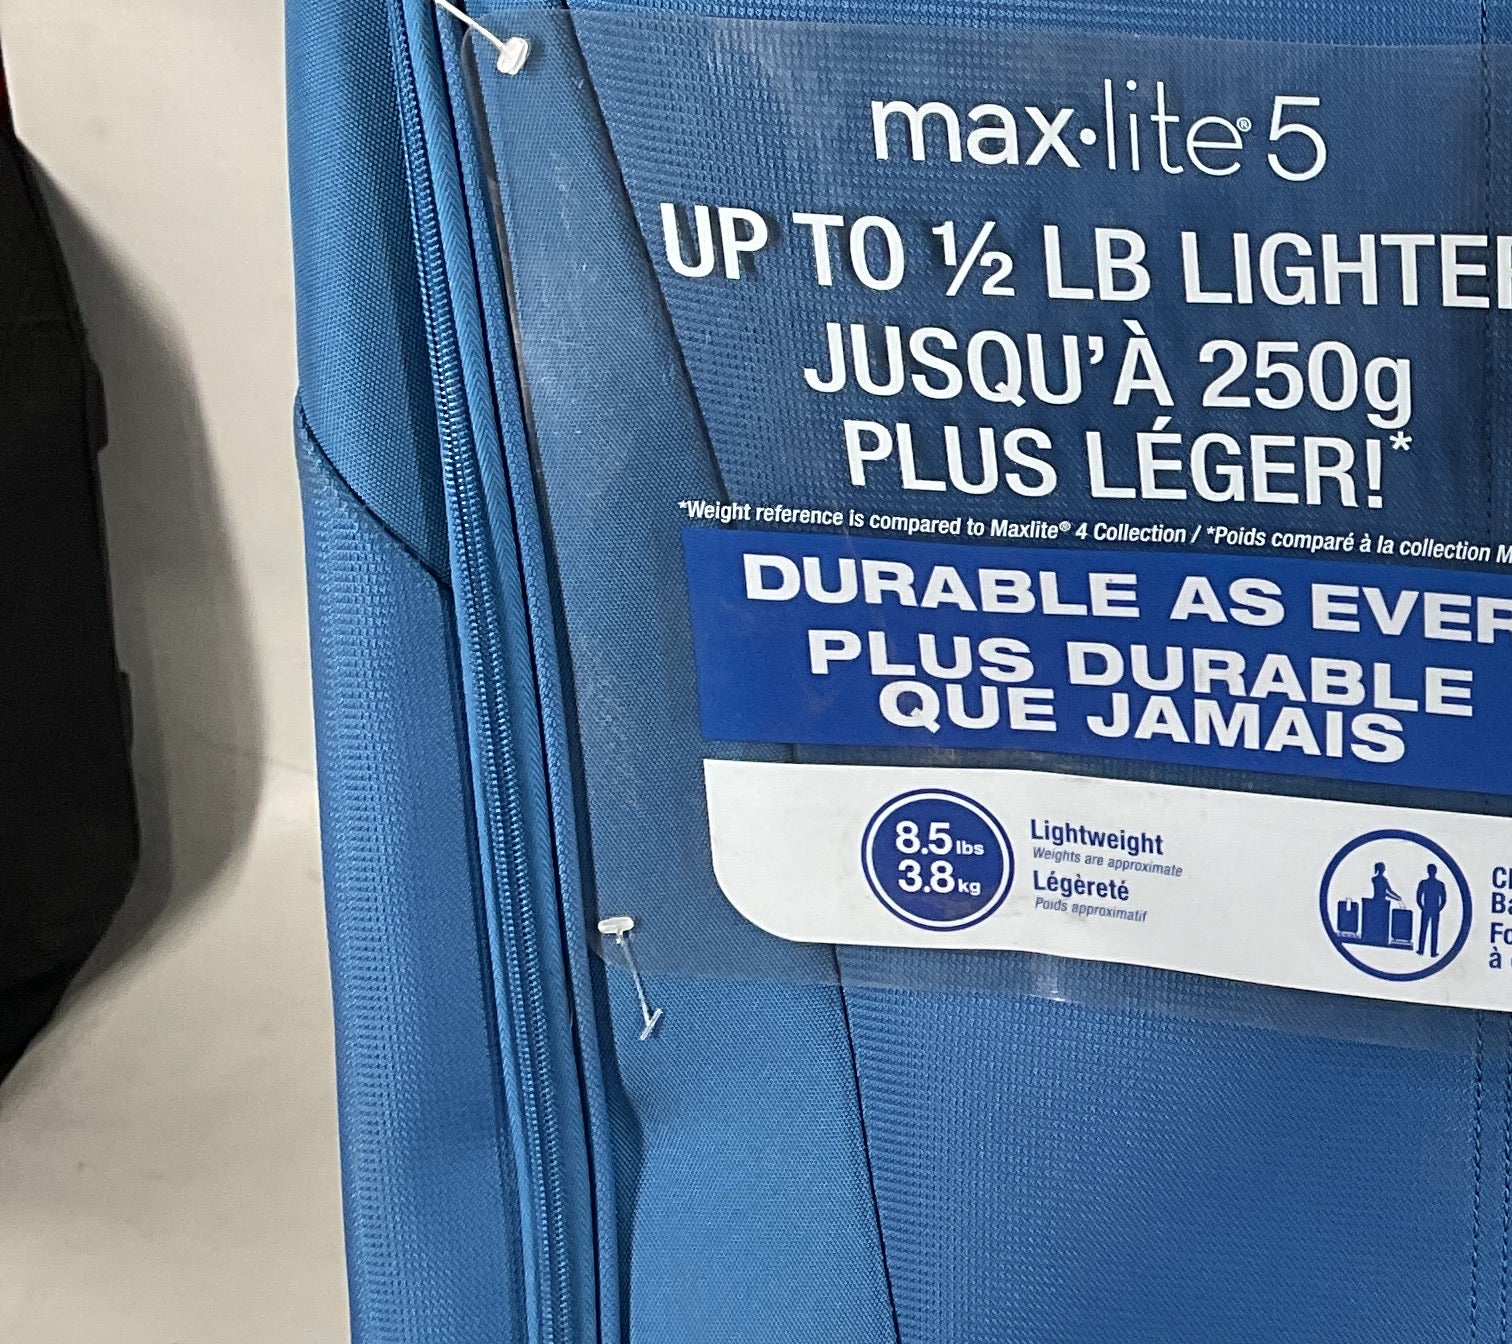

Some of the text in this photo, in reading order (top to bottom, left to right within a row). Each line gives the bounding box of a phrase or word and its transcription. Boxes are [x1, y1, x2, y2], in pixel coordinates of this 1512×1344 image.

[1267, 94, 1328, 182] 5
[660, 202, 768, 280] UP
[793, 211, 904, 290] TO
[1045, 223, 1150, 301] LB
[1199, 338, 1412, 428] 250g
[844, 420, 1053, 498] PLUS
[755, 506, 843, 526] reference
[848, 508, 865, 528] is
[869, 512, 961, 537] compared
[966, 517, 985, 536] to
[1075, 522, 1088, 540] 4
[1093, 521, 1187, 544] Collection
[1190, 524, 1202, 545] /
[1271, 532, 1354, 556] comparé
[1359, 535, 1372, 554] à
[1376, 535, 1394, 555] la
[1399, 538, 1490, 562] collection
[742, 554, 1139, 618] DURABLE
[1171, 575, 1288, 629] AS
[808, 629, 1474, 717] PLUS DURABLE
[878, 680, 1405, 763] QUE JAMAIS
[1030, 819, 1164, 856] Lightweight
[1032, 846, 1183, 877] Weights are approximate
[1033, 870, 1130, 901] Légèreté
[1034, 896, 1148, 922] Poids approximatif
[1488, 946, 1502, 969] à
